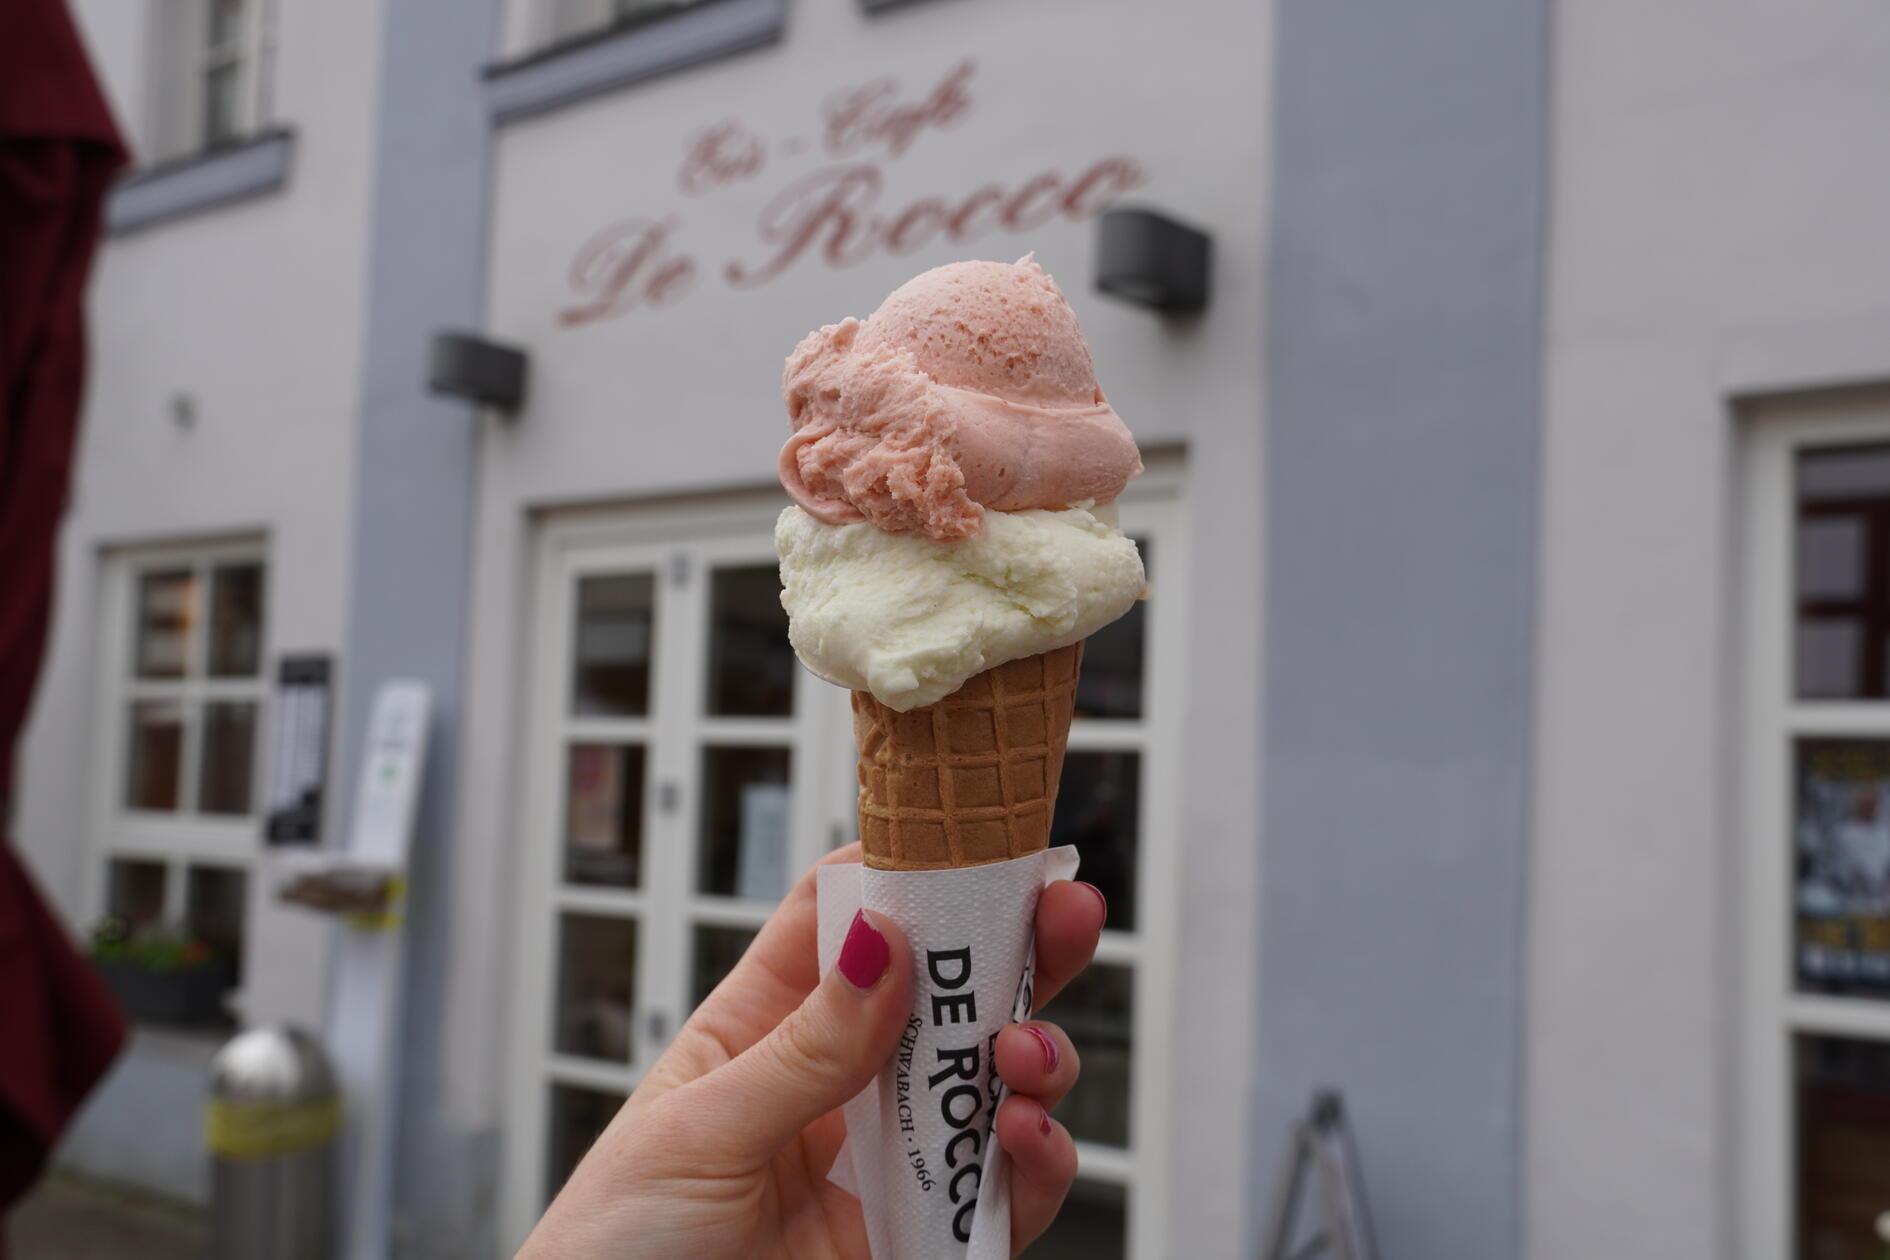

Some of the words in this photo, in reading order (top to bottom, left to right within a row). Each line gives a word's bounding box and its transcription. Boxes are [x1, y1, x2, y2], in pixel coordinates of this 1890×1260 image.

[560, 217, 697, 325] De
[725, 157, 1143, 286] Rocco
[926, 944, 978, 1027] DE
[897, 1013, 923, 1133] SCHWABACH
[908, 1149, 937, 1192] 1966
[927, 1043, 983, 1244] ROCCO
